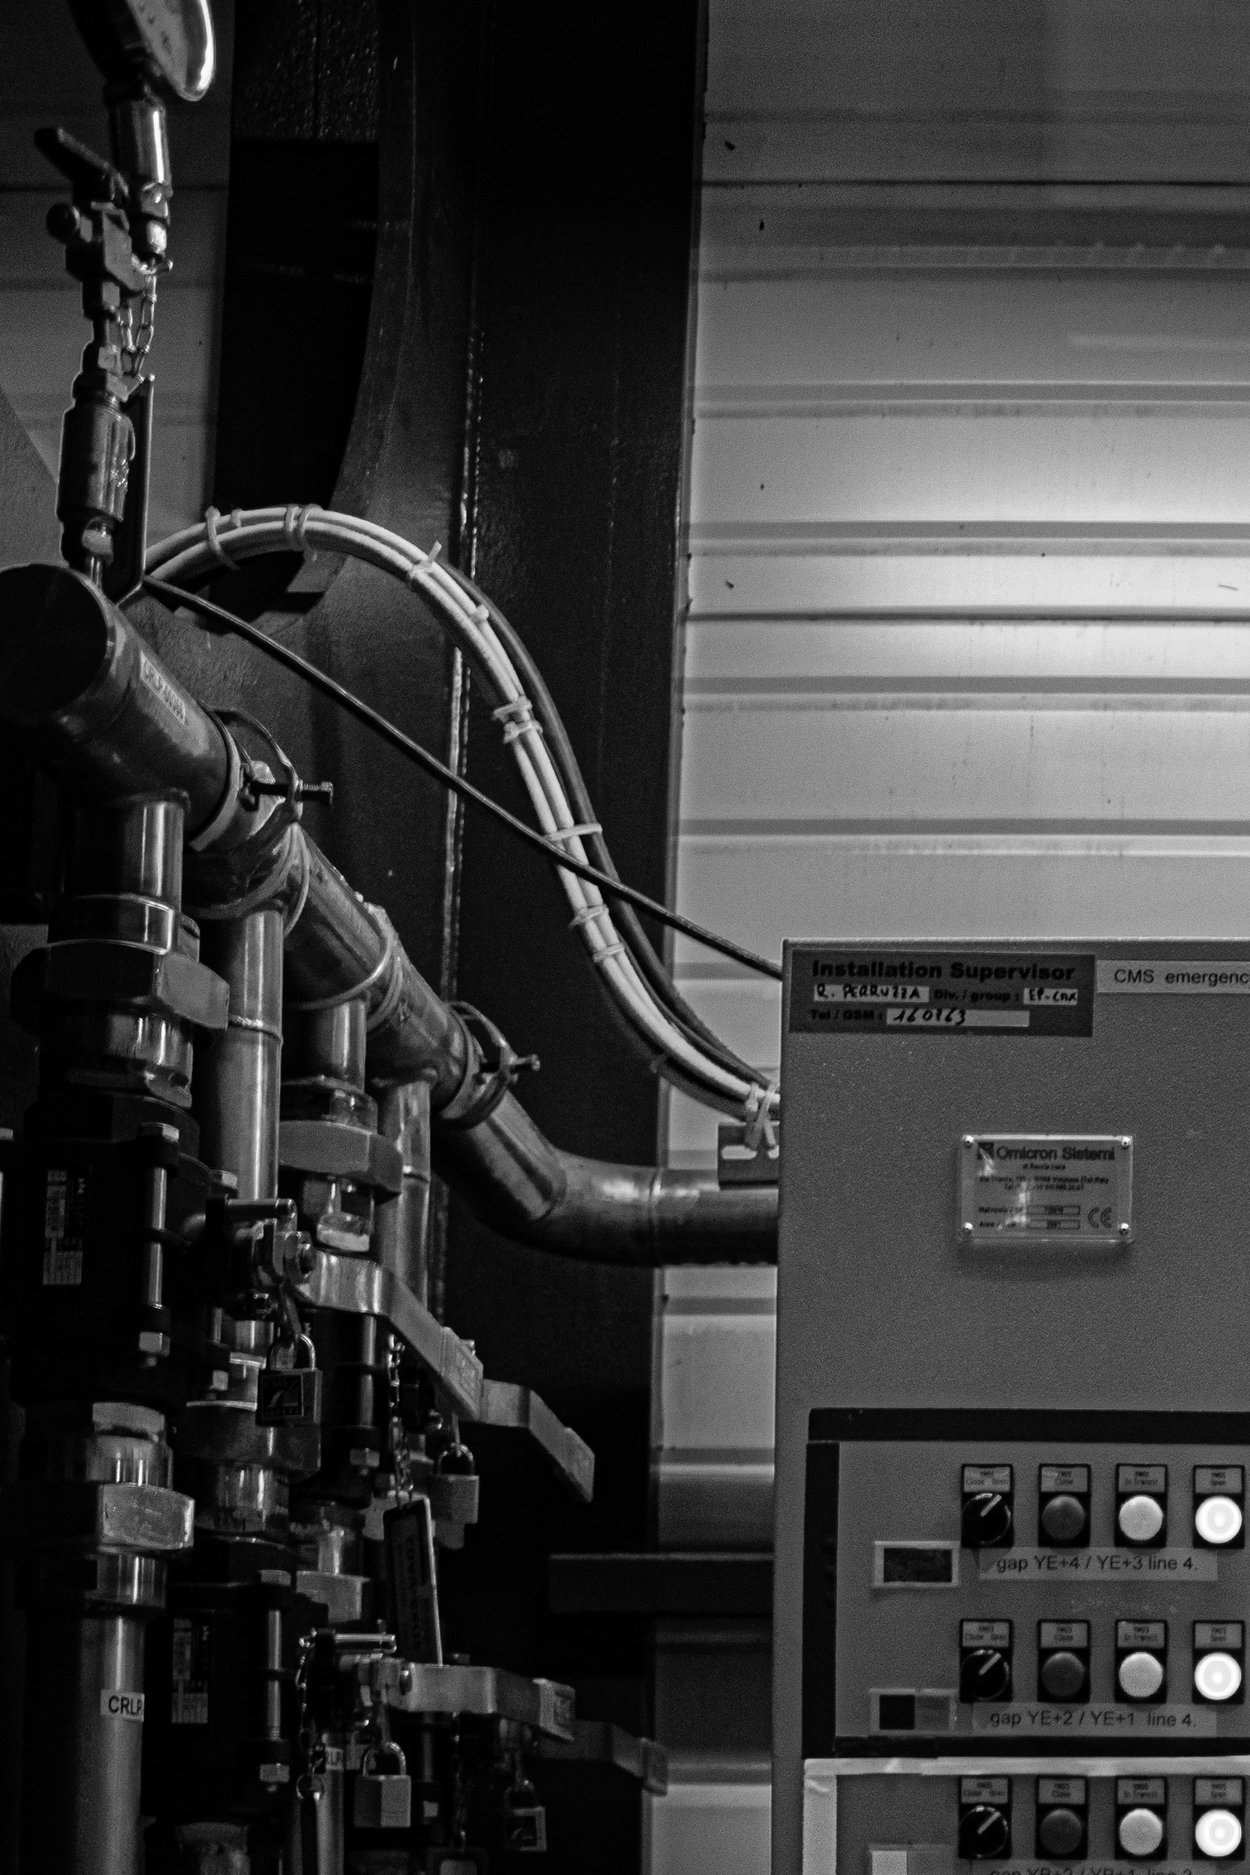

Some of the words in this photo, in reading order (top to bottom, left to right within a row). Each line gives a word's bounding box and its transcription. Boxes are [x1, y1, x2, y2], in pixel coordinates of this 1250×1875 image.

[813, 960, 942, 980] Installation
[949, 961, 1077, 983] Supervisor
[1114, 970, 1155, 984] CMS
[971, 991, 1011, 1003] group
[996, 1145, 1058, 1161] Omicron
[997, 1558, 1028, 1573] gap
[1034, 1556, 1079, 1570] YE+4
[1085, 1556, 1092, 1570] /
[1097, 1556, 1143, 1570] YE+3
[1148, 1556, 1177, 1570] line
[990, 1711, 1022, 1728] gap
[1028, 1710, 1073, 1726] YE+2
[1078, 1710, 1086, 1726] /
[1090, 1711, 1134, 1726] YE+1
[1147, 1712, 1177, 1727] line
